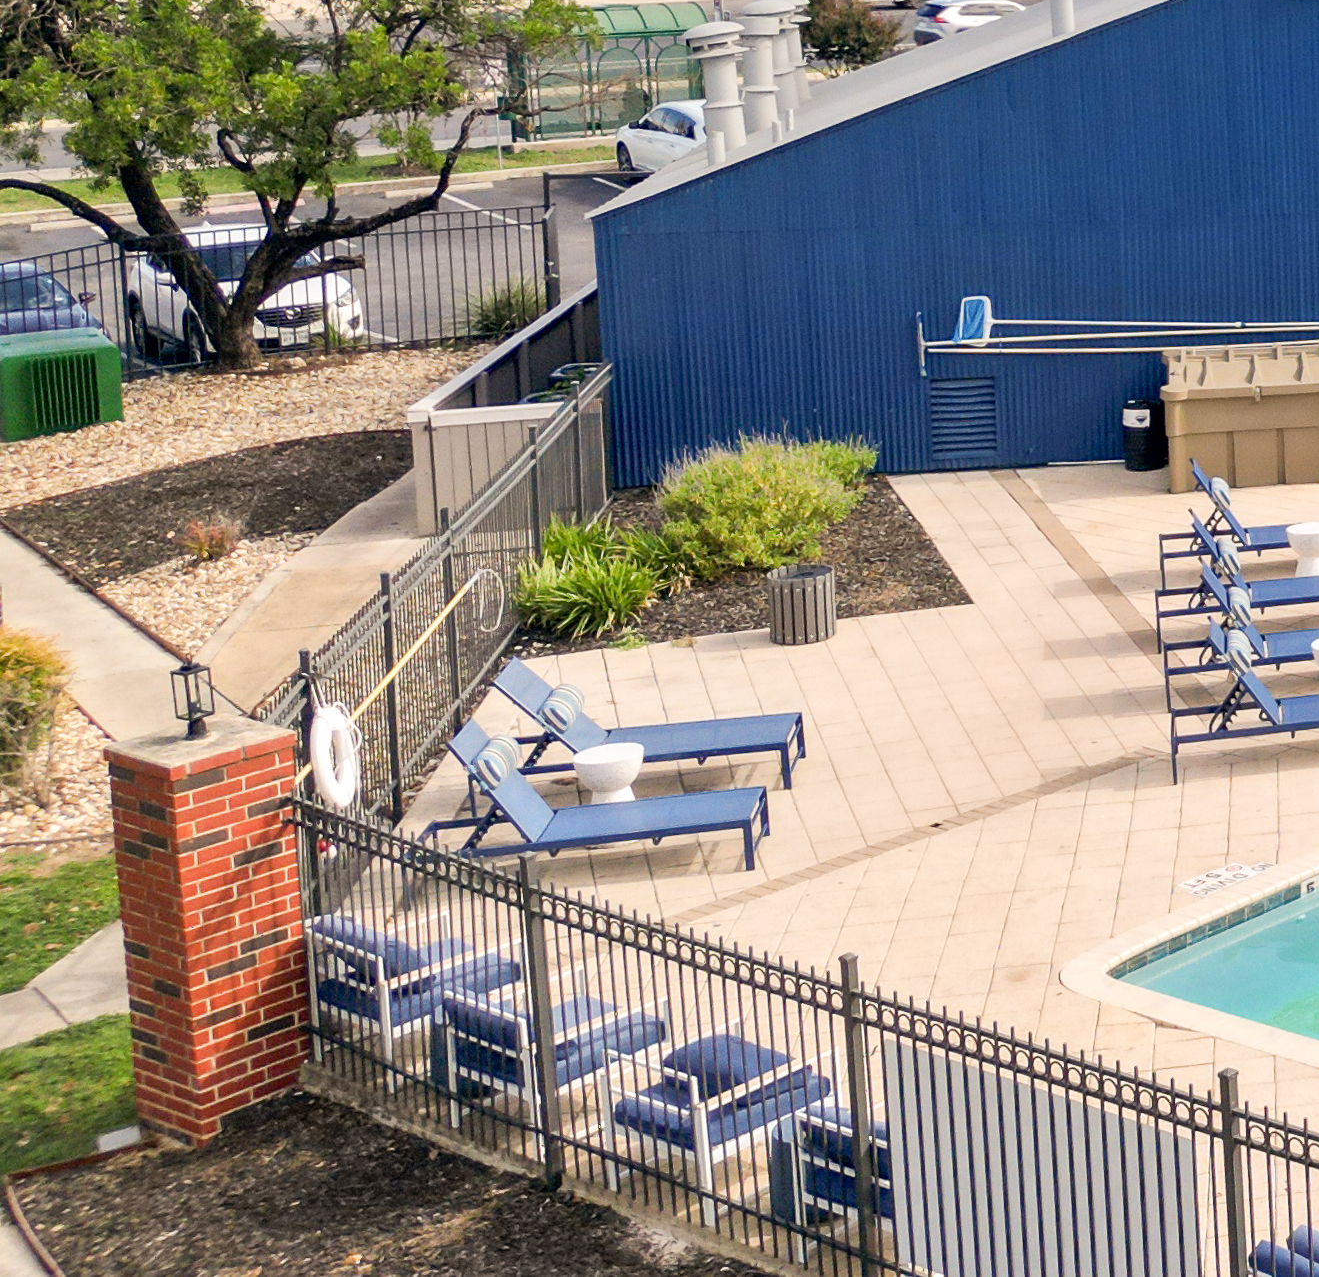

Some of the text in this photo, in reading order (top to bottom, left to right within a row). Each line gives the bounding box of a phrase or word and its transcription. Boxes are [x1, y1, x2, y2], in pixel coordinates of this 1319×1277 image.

[1184, 878, 1207, 888] FT
[1194, 862, 1274, 896] NO DIVING
